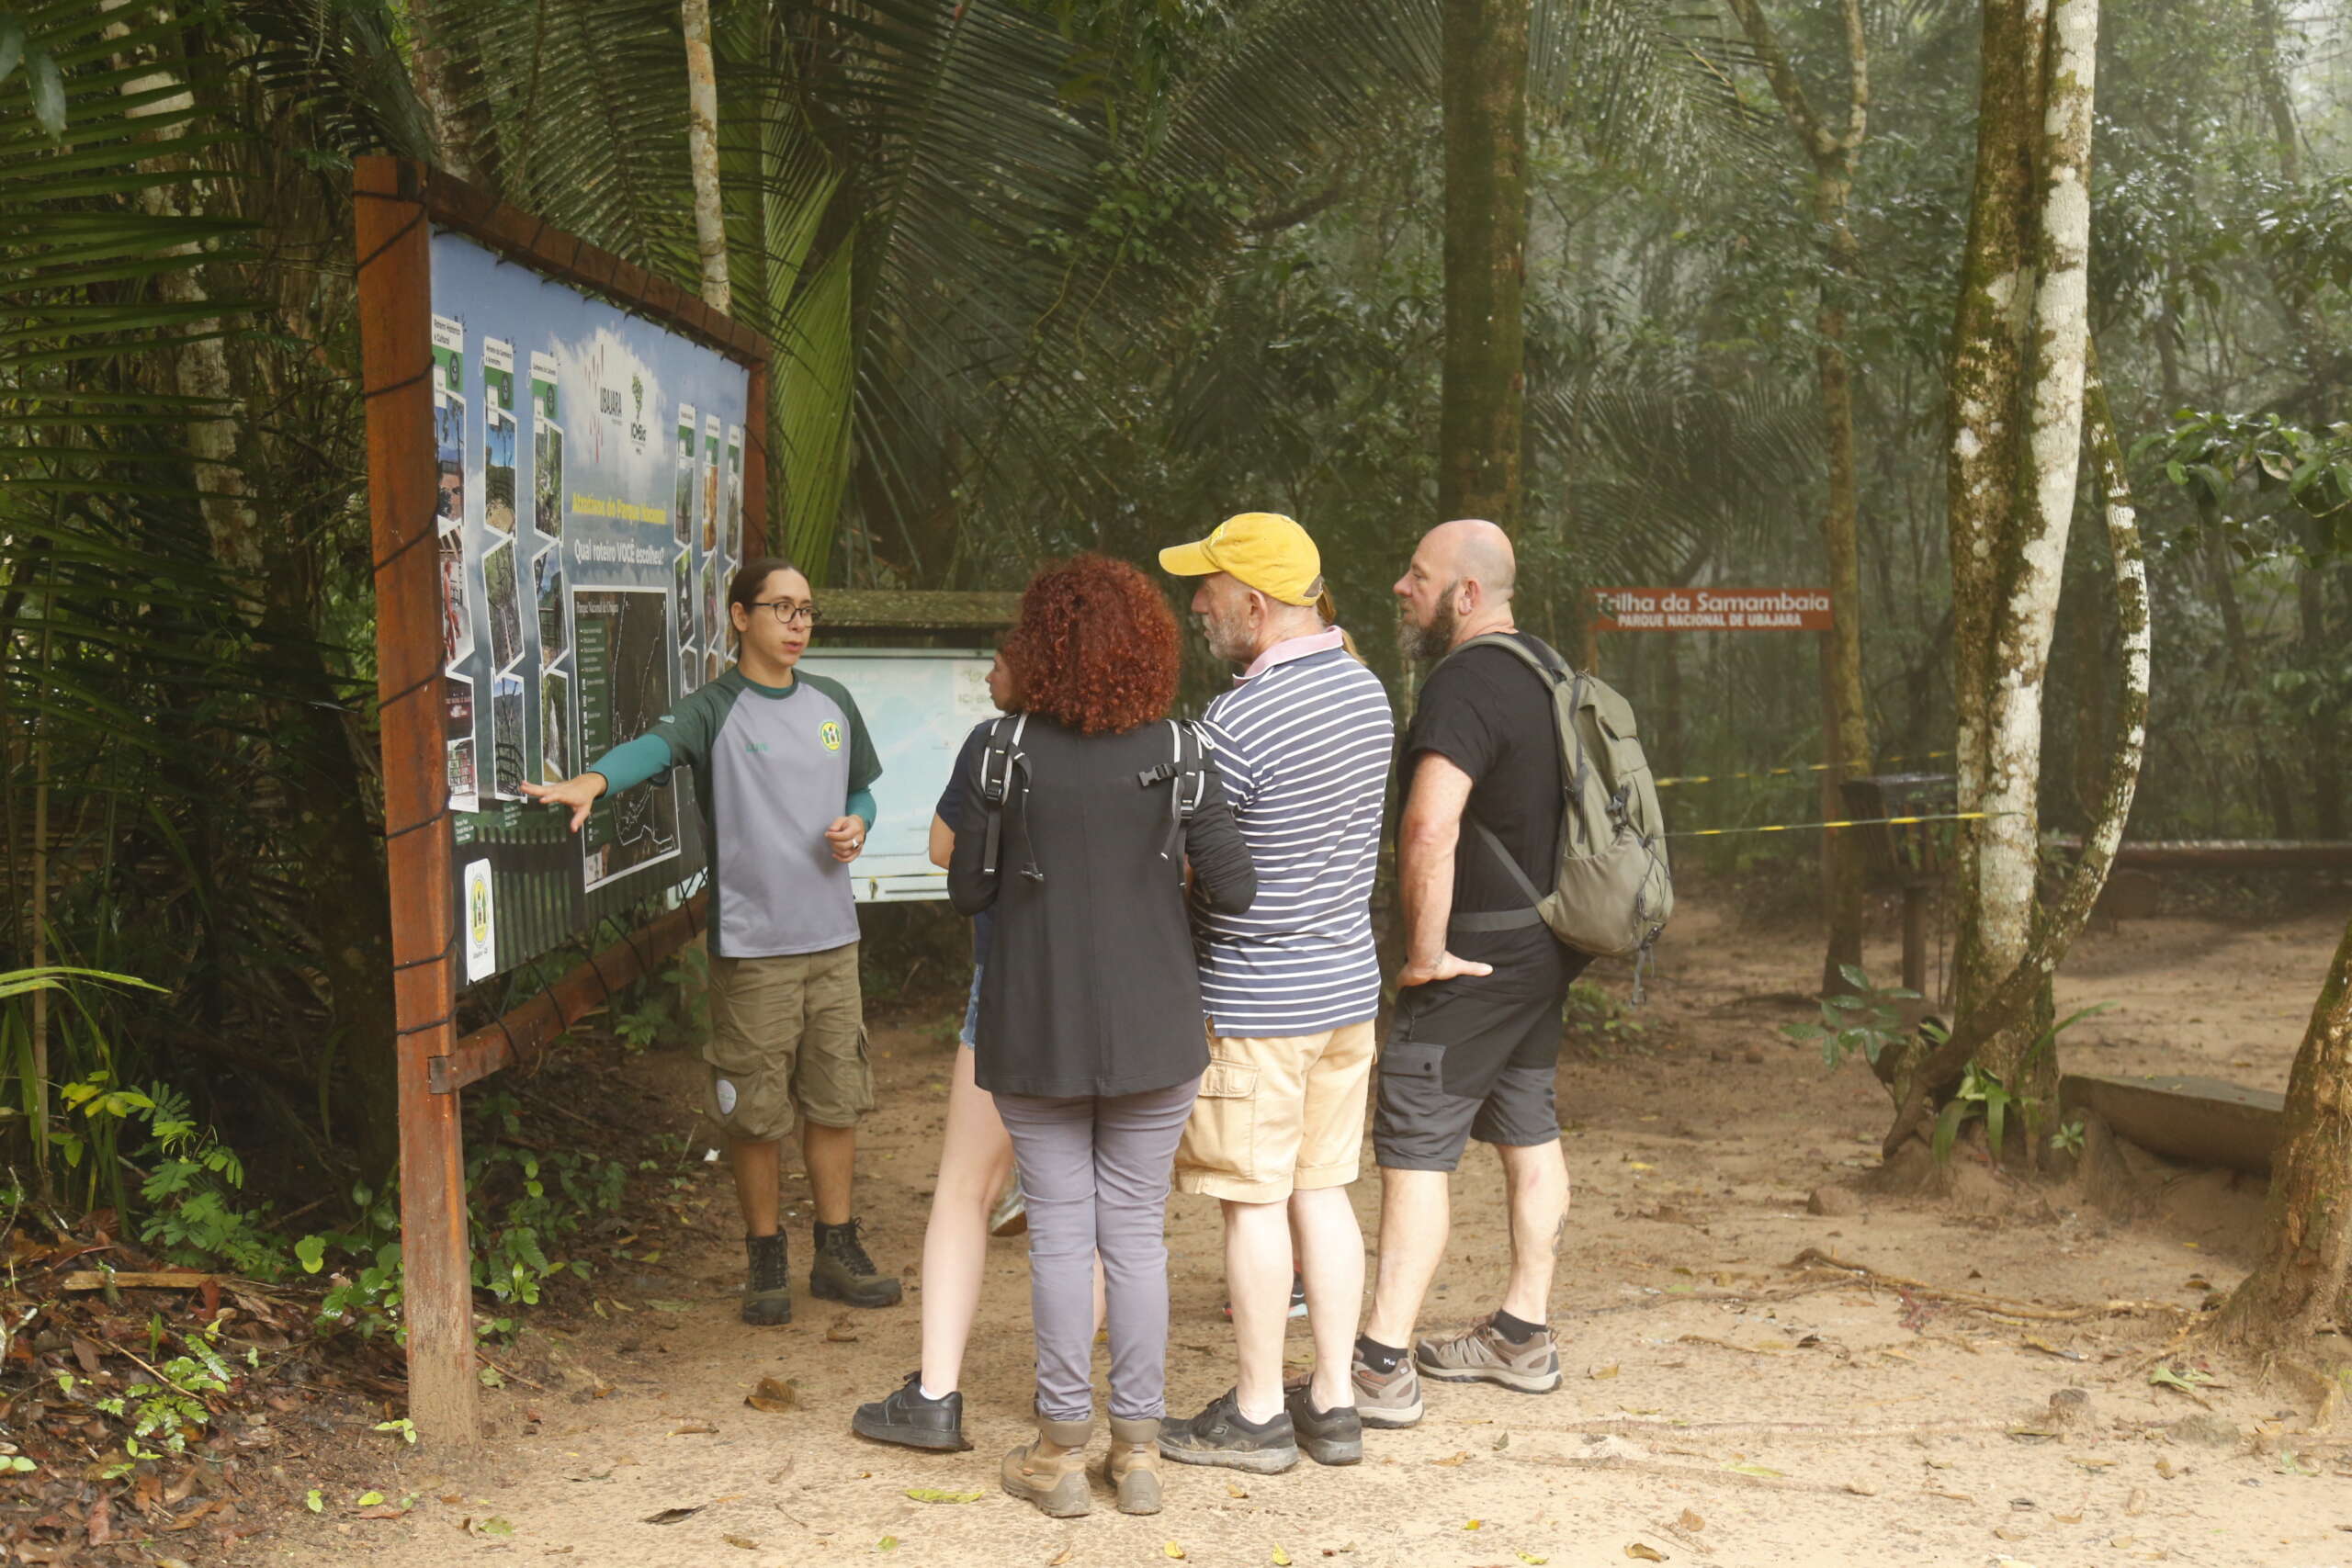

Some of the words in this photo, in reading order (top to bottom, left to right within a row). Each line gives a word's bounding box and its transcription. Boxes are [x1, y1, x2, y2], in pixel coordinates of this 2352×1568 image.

[600, 387, 622, 418] UBAJARA
[616, 499, 640, 525] Parque
[574, 538, 592, 565] Qual
[593, 540, 616, 562] roteiro
[616, 537, 635, 564] VOCÊ
[636, 545, 664, 566] escolheu?
[1660, 592, 1690, 612] da
[1697, 592, 1829, 612] Samambaia
[1617, 615, 1664, 627] PARQUE
[1668, 614, 1726, 627] NACIONAL
[1729, 614, 1745, 627] DE
[1747, 614, 1803, 627] UBAJARA
